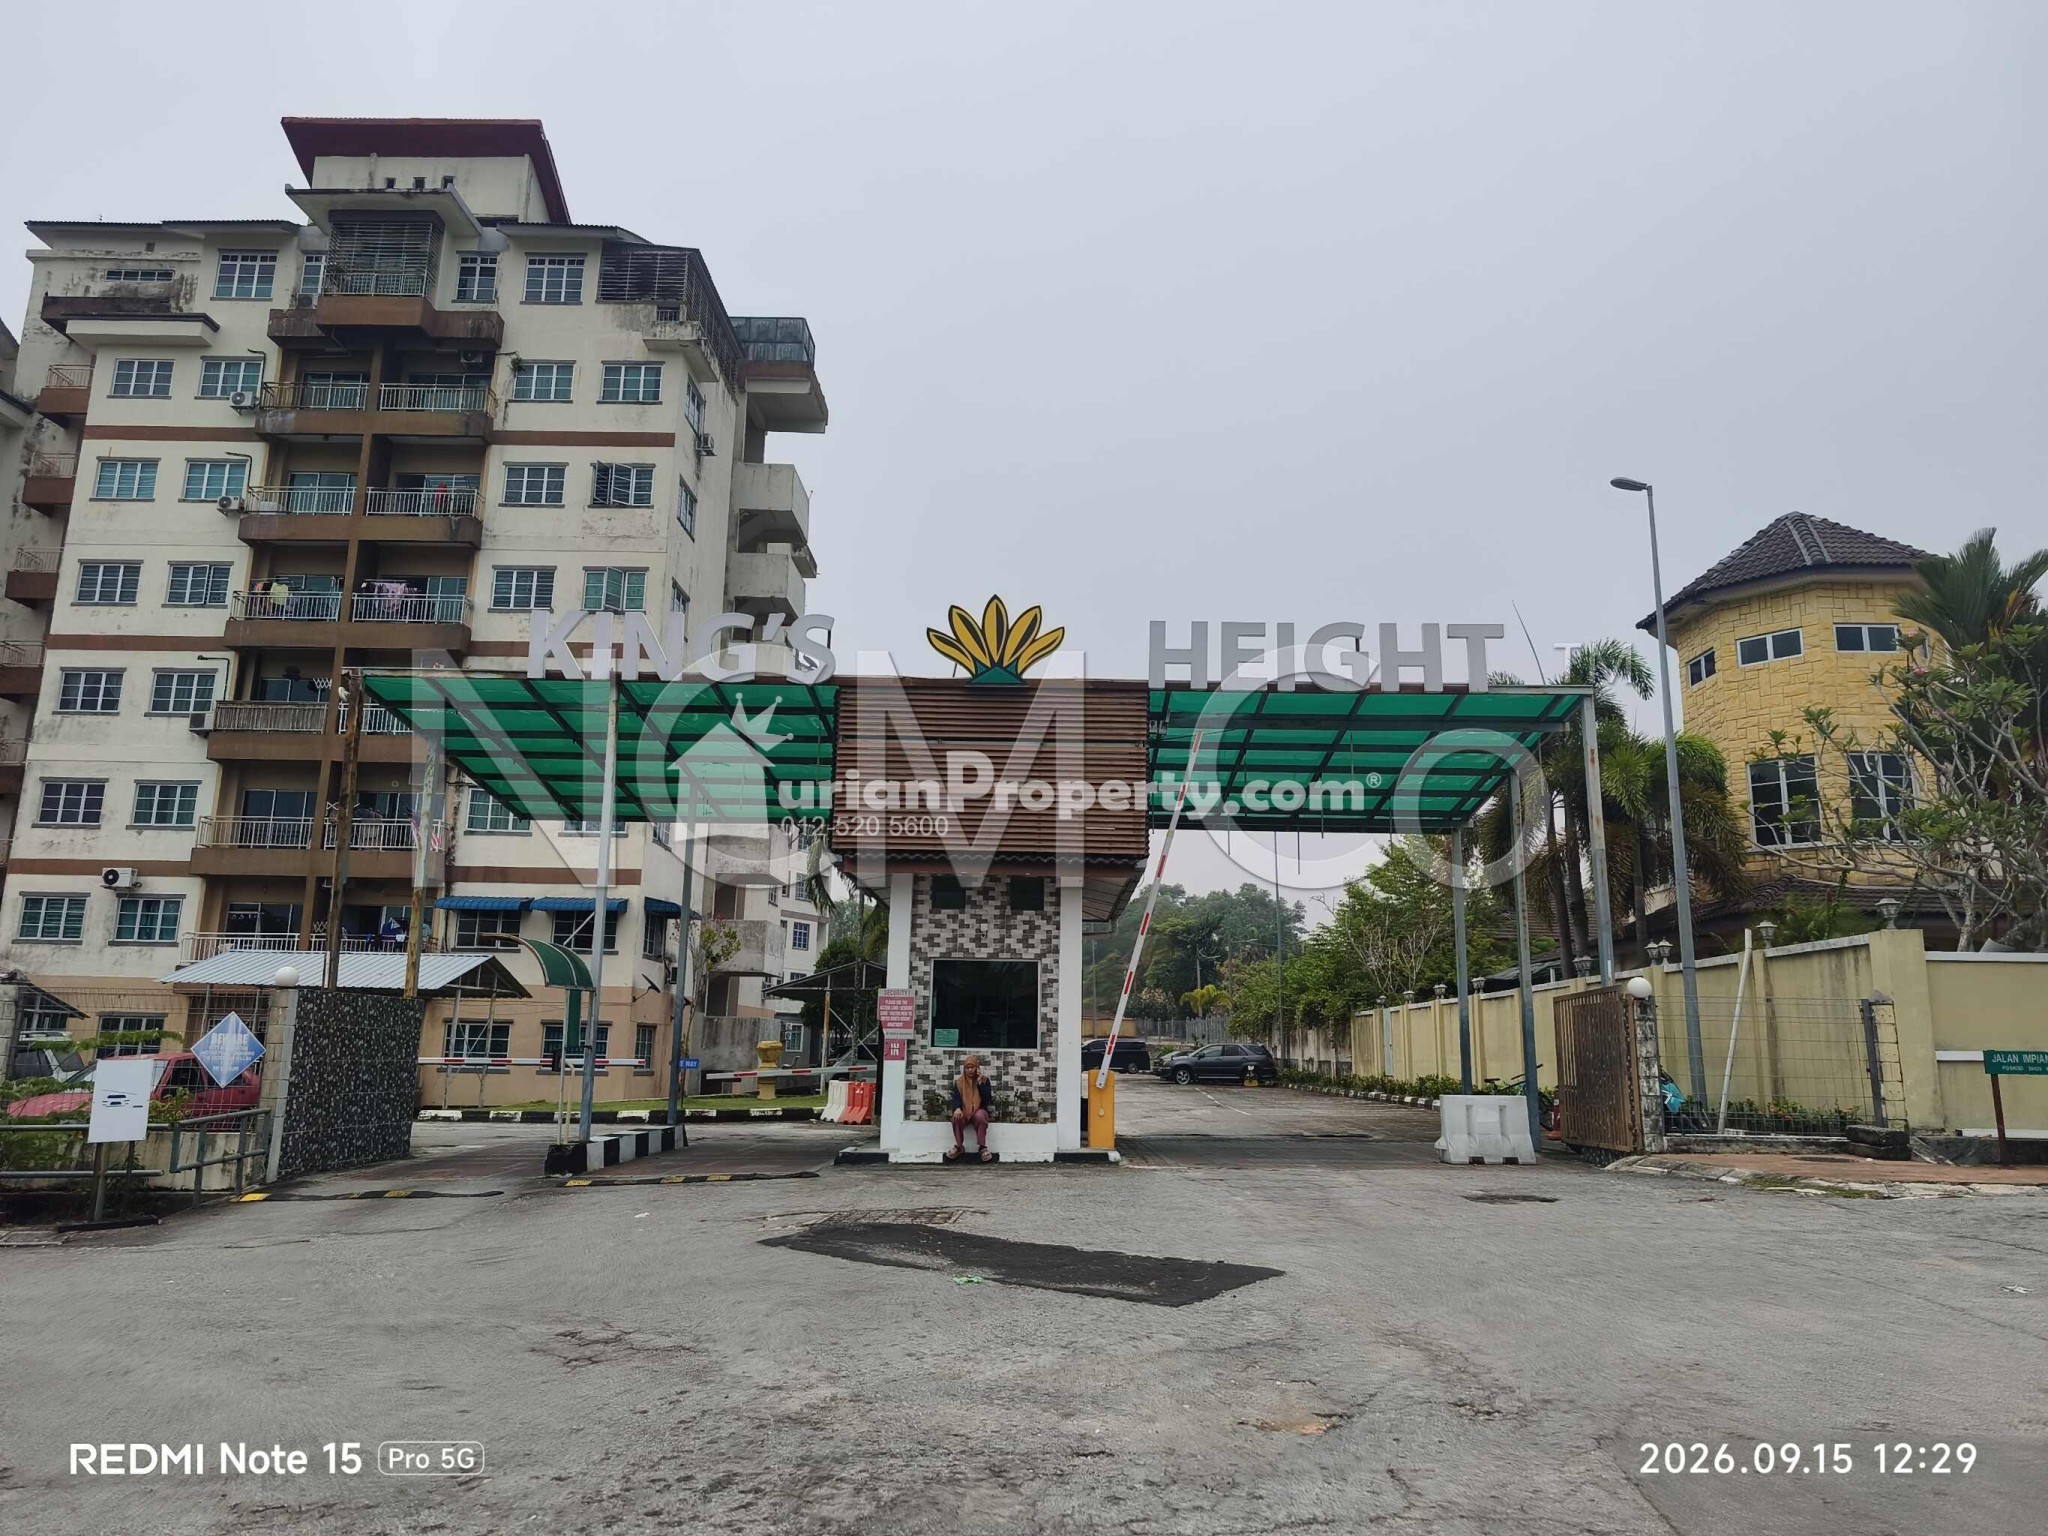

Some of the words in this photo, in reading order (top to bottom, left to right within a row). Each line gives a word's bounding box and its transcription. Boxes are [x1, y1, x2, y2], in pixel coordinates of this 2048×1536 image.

[527, 609, 837, 684] KING'S
[1149, 619, 1505, 693] HEIGHT
[211, 1033, 249, 1044] BEWRE
[1992, 1053, 2019, 1063] JALAN
